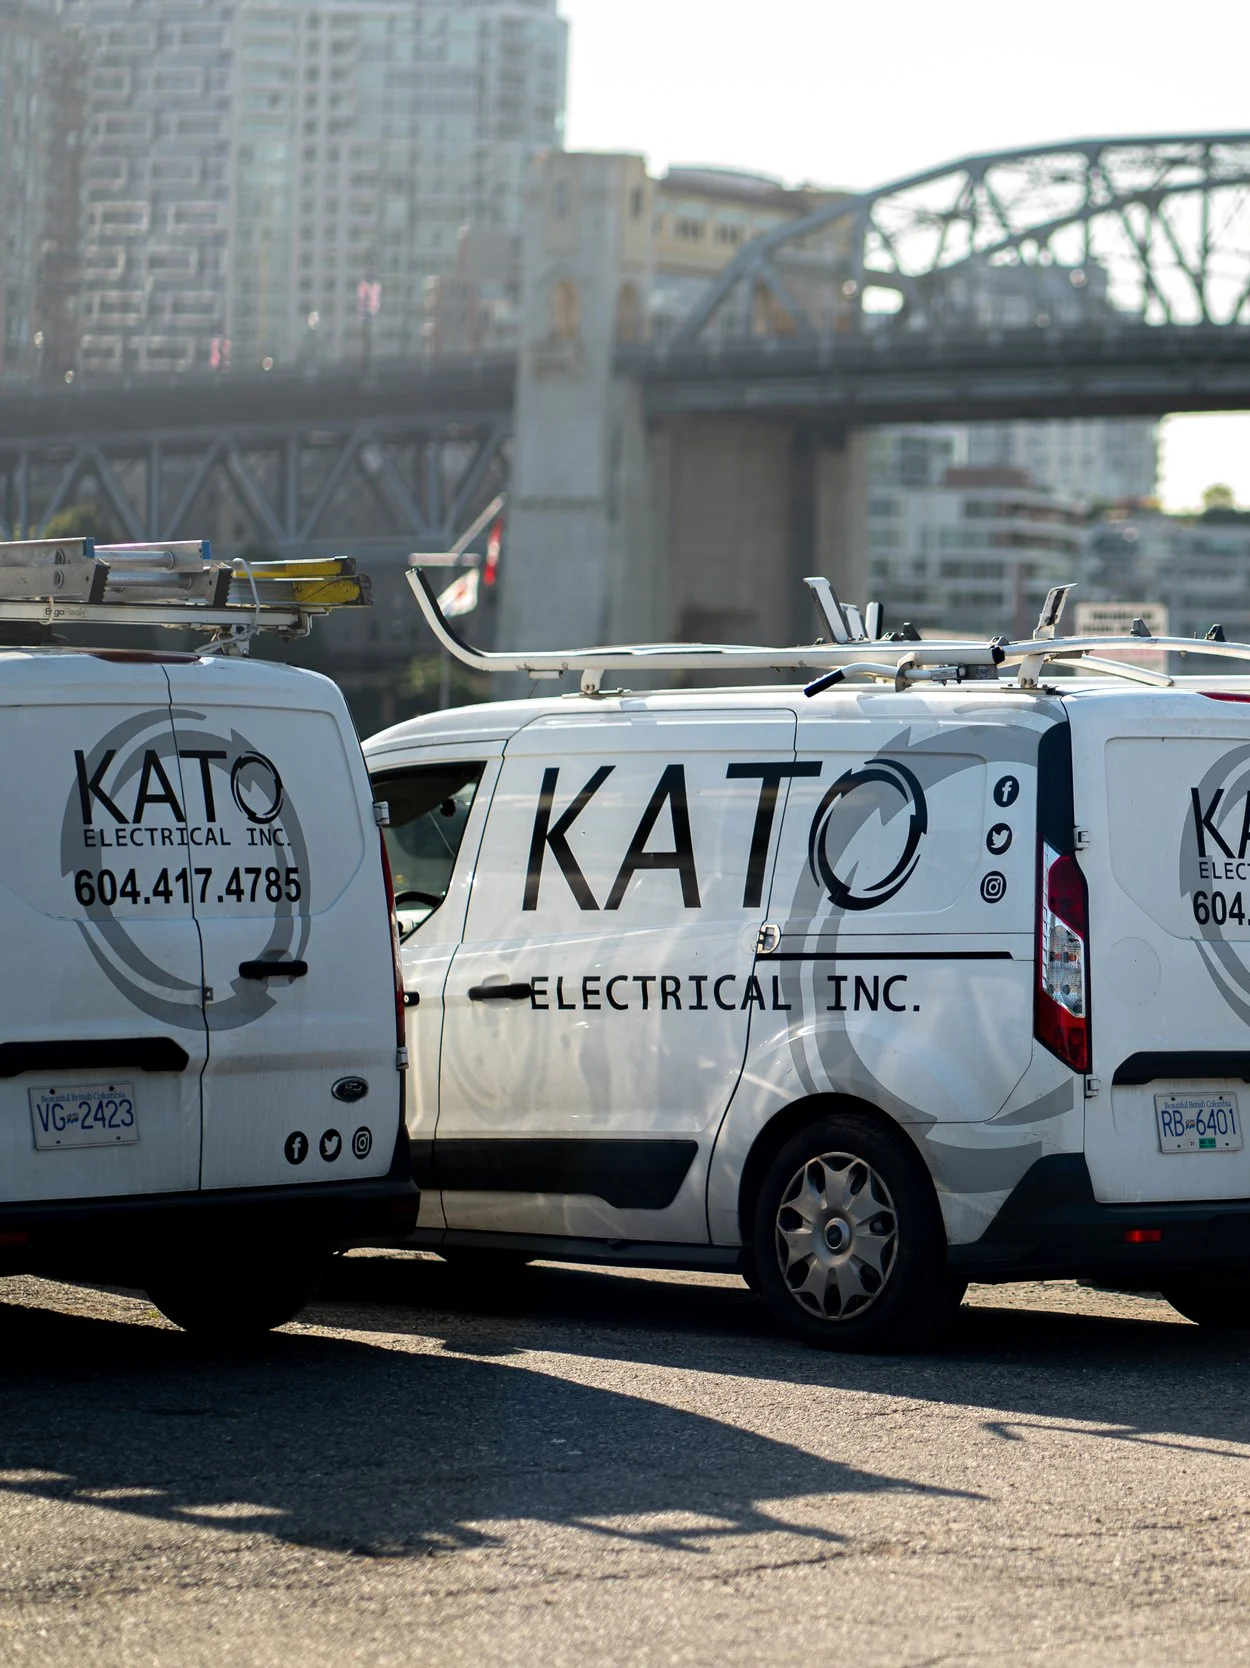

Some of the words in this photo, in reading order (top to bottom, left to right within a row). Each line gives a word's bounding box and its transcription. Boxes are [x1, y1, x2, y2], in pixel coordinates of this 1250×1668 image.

[74, 749, 284, 825] KATO
[83, 827, 231, 848] ELECTRICAL
[246, 827, 291, 847] INC.
[522, 758, 928, 912] KATO
[74, 867, 302, 906] 604.417.4785
[530, 974, 792, 1011] ELECTRICAL
[827, 974, 921, 1013] INC.
[71, 1092, 93, 1102] British
[93, 1090, 126, 1100] Columbia
[1189, 1100, 1205, 1108] British
[1205, 1099, 1232, 1108] Columbia
[36, 1103, 66, 1132] VG
[78, 1099, 134, 1129] 2423
[1161, 1110, 1185, 1137] RB
[1196, 1108, 1236, 1136] 6401
